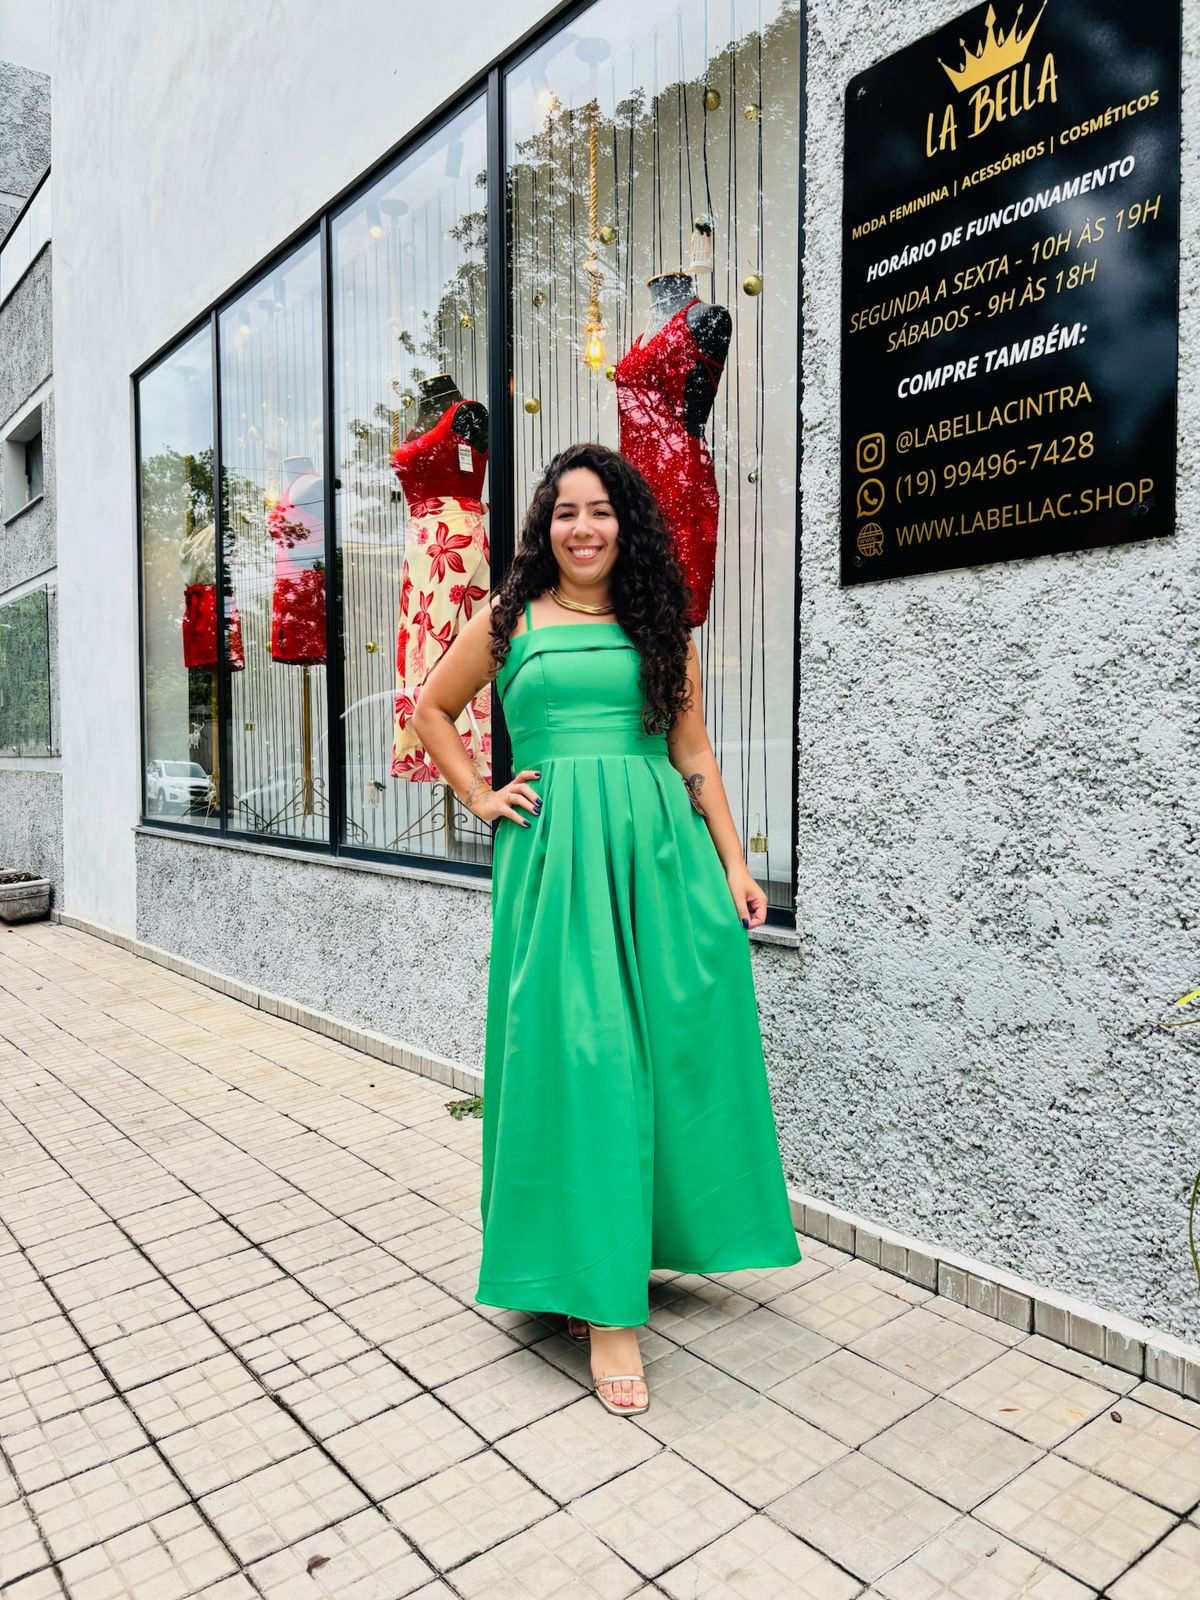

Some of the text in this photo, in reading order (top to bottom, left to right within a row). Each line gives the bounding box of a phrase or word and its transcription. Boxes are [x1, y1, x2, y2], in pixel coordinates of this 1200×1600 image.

[926, 52, 1058, 158] LA BELLA
[852, 214, 887, 240] MODA
[889, 185, 949, 223] FEMININA
[961, 141, 1045, 190] ACESSÓRIOS
[1060, 90, 1160, 145] COSMÉTICOS
[849, 287, 930, 334] SEGUNDA
[934, 278, 947, 302] A
[952, 254, 1010, 295] SEXTA
[1031, 229, 1071, 265] 10H
[1076, 217, 1106, 248] ÀS
[1115, 194, 1162, 233] 19H
[867, 155, 1136, 283] HORÁRIO DE FUNCIONAMENTO
[887, 305, 970, 352] SÁBADOS
[987, 287, 1016, 318] 9H
[1019, 277, 1047, 307] ÀS
[1054, 259, 1098, 294] 18H
[897, 322, 1088, 399] COMPRE TAMBÉM:
[896, 381, 1093, 454] @LABELLACINTRA
[896, 431, 1095, 504] (19) 99496-7428
[896, 478, 1154, 547] WWW.LABELLAC.SHOP
